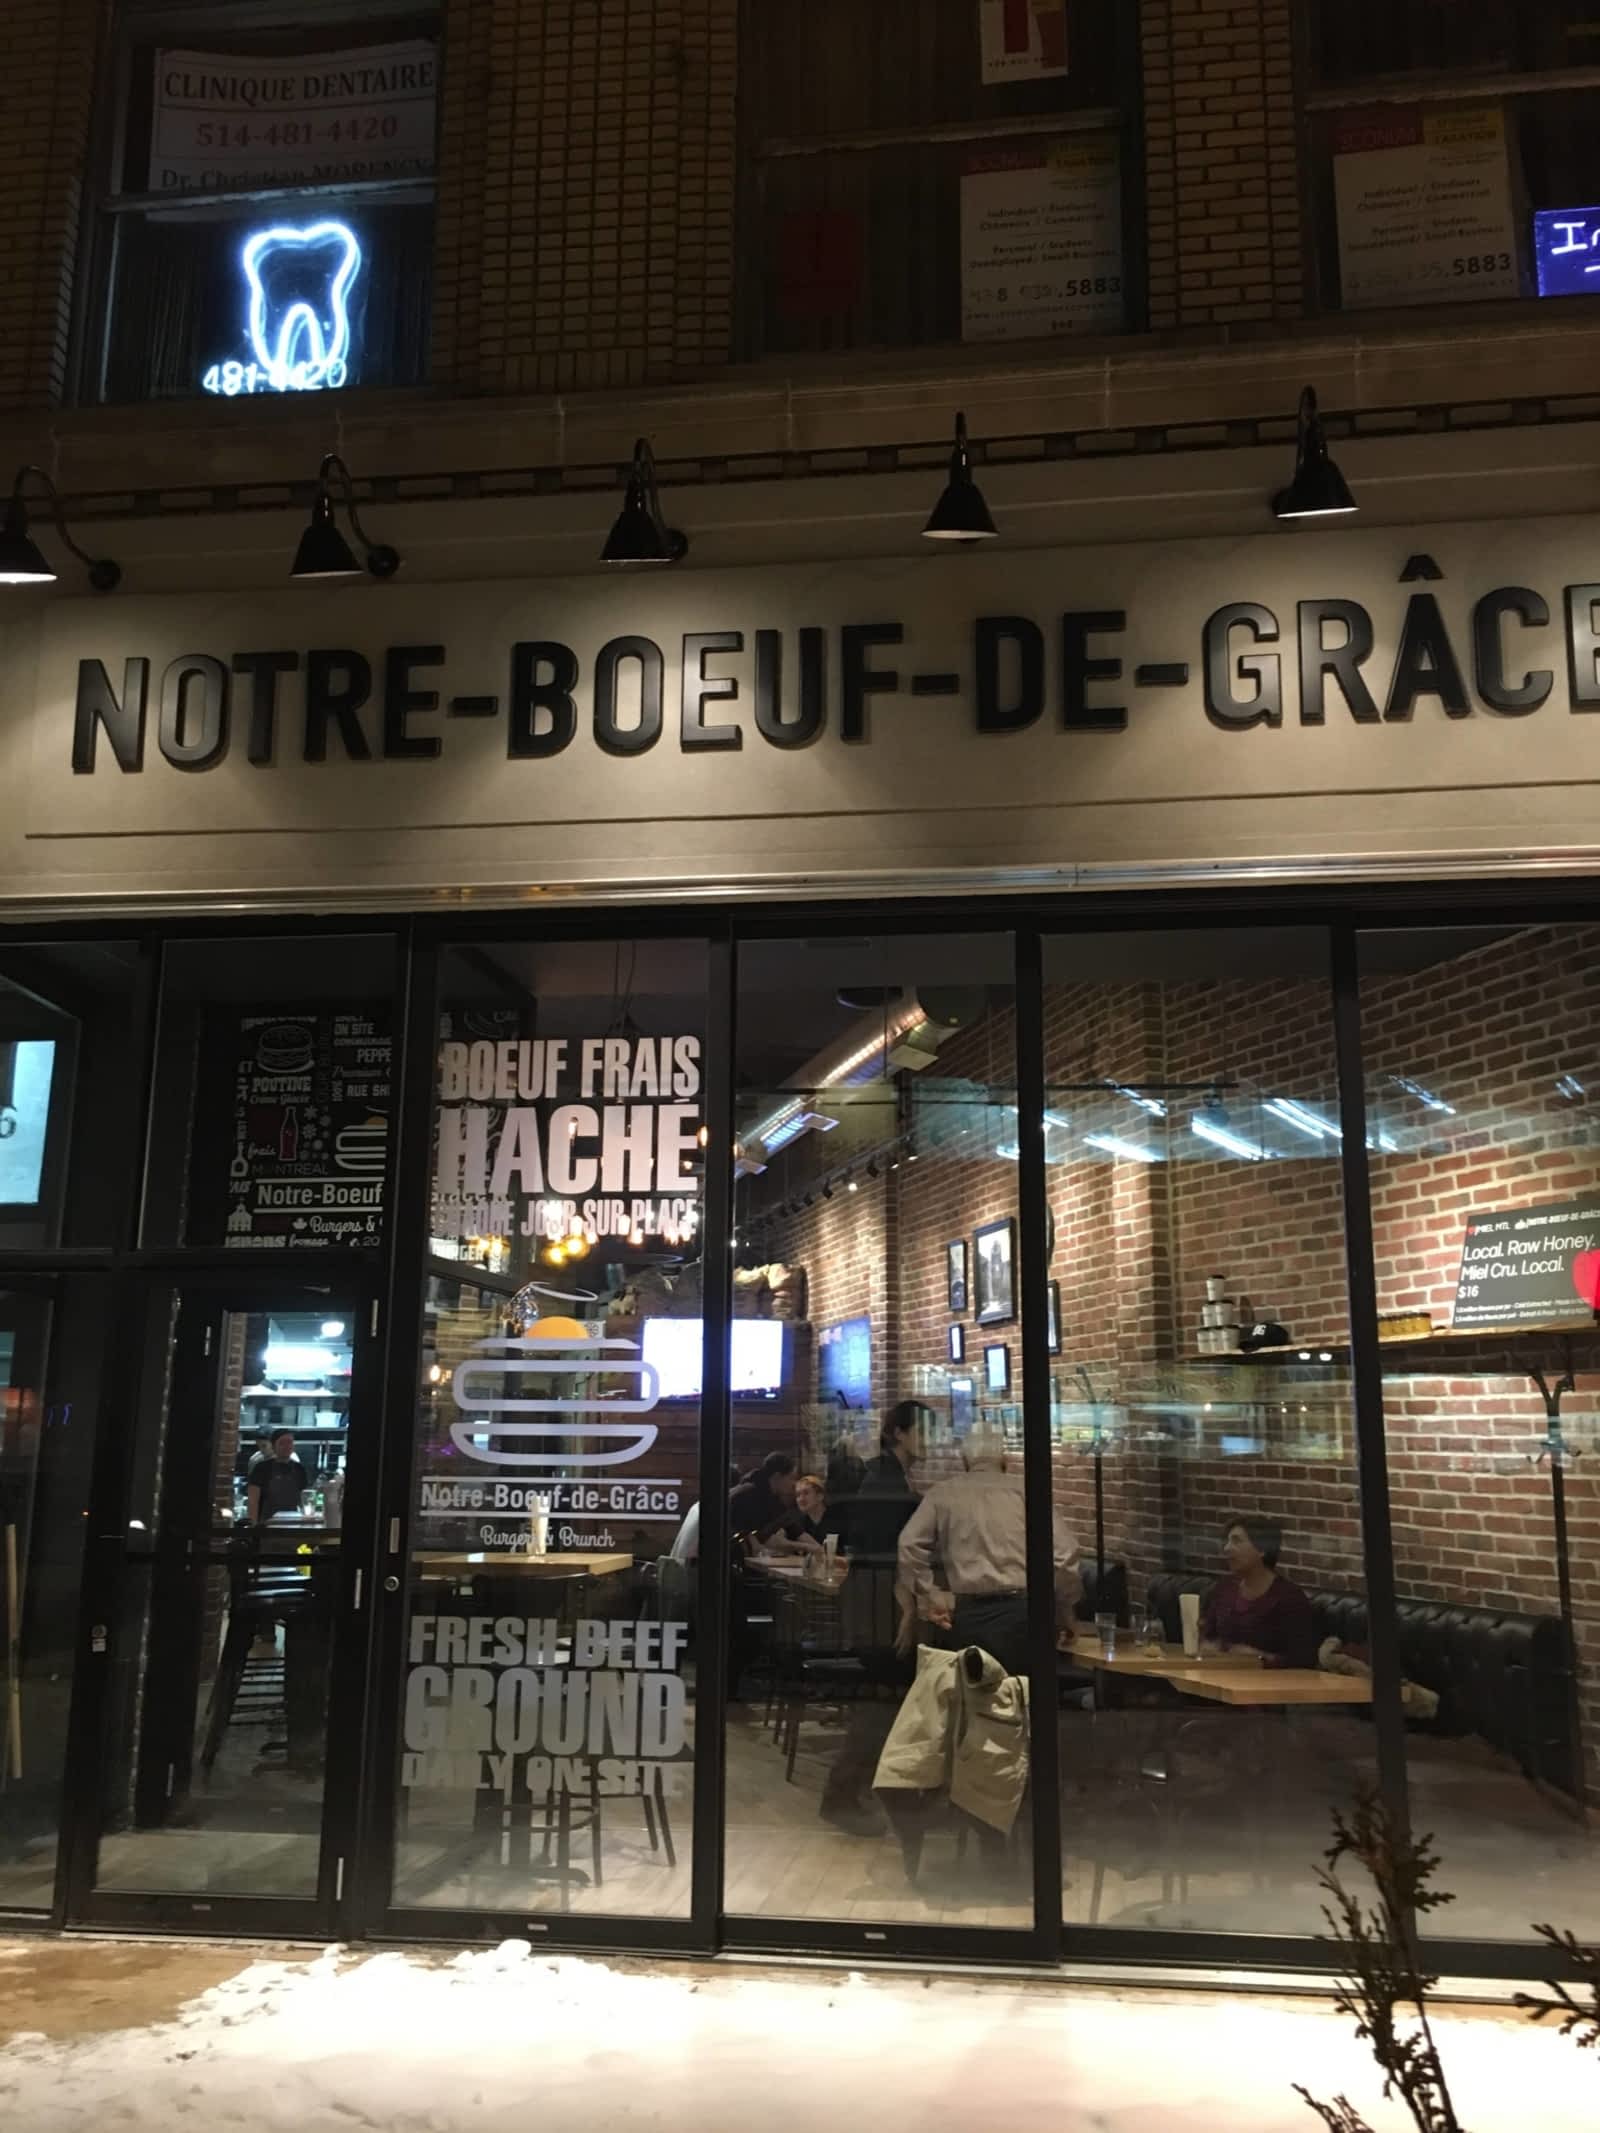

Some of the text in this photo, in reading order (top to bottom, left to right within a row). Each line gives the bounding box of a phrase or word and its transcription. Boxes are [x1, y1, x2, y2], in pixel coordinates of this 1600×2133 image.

[165, 61, 433, 106] CLINIQUE DENTAIRE
[195, 115, 398, 147] 514-481-4420
[439, 1035, 700, 1101] BOEUF FRAIS
[583, 1198, 627, 1236] SUR
[631, 1198, 698, 1236] PLACE
[1463, 1233, 1596, 1261] Local. Raw Honey.
[1461, 1255, 1565, 1281] Miel Cru. Local.
[1458, 1285, 1479, 1299] $16
[421, 1483, 679, 1512] Notre-Boeuf-de-Grâce
[559, 1525, 616, 1549] Brunch
[408, 1615, 689, 1669] FRESH BEEF
[404, 1665, 687, 1757] GROUND
